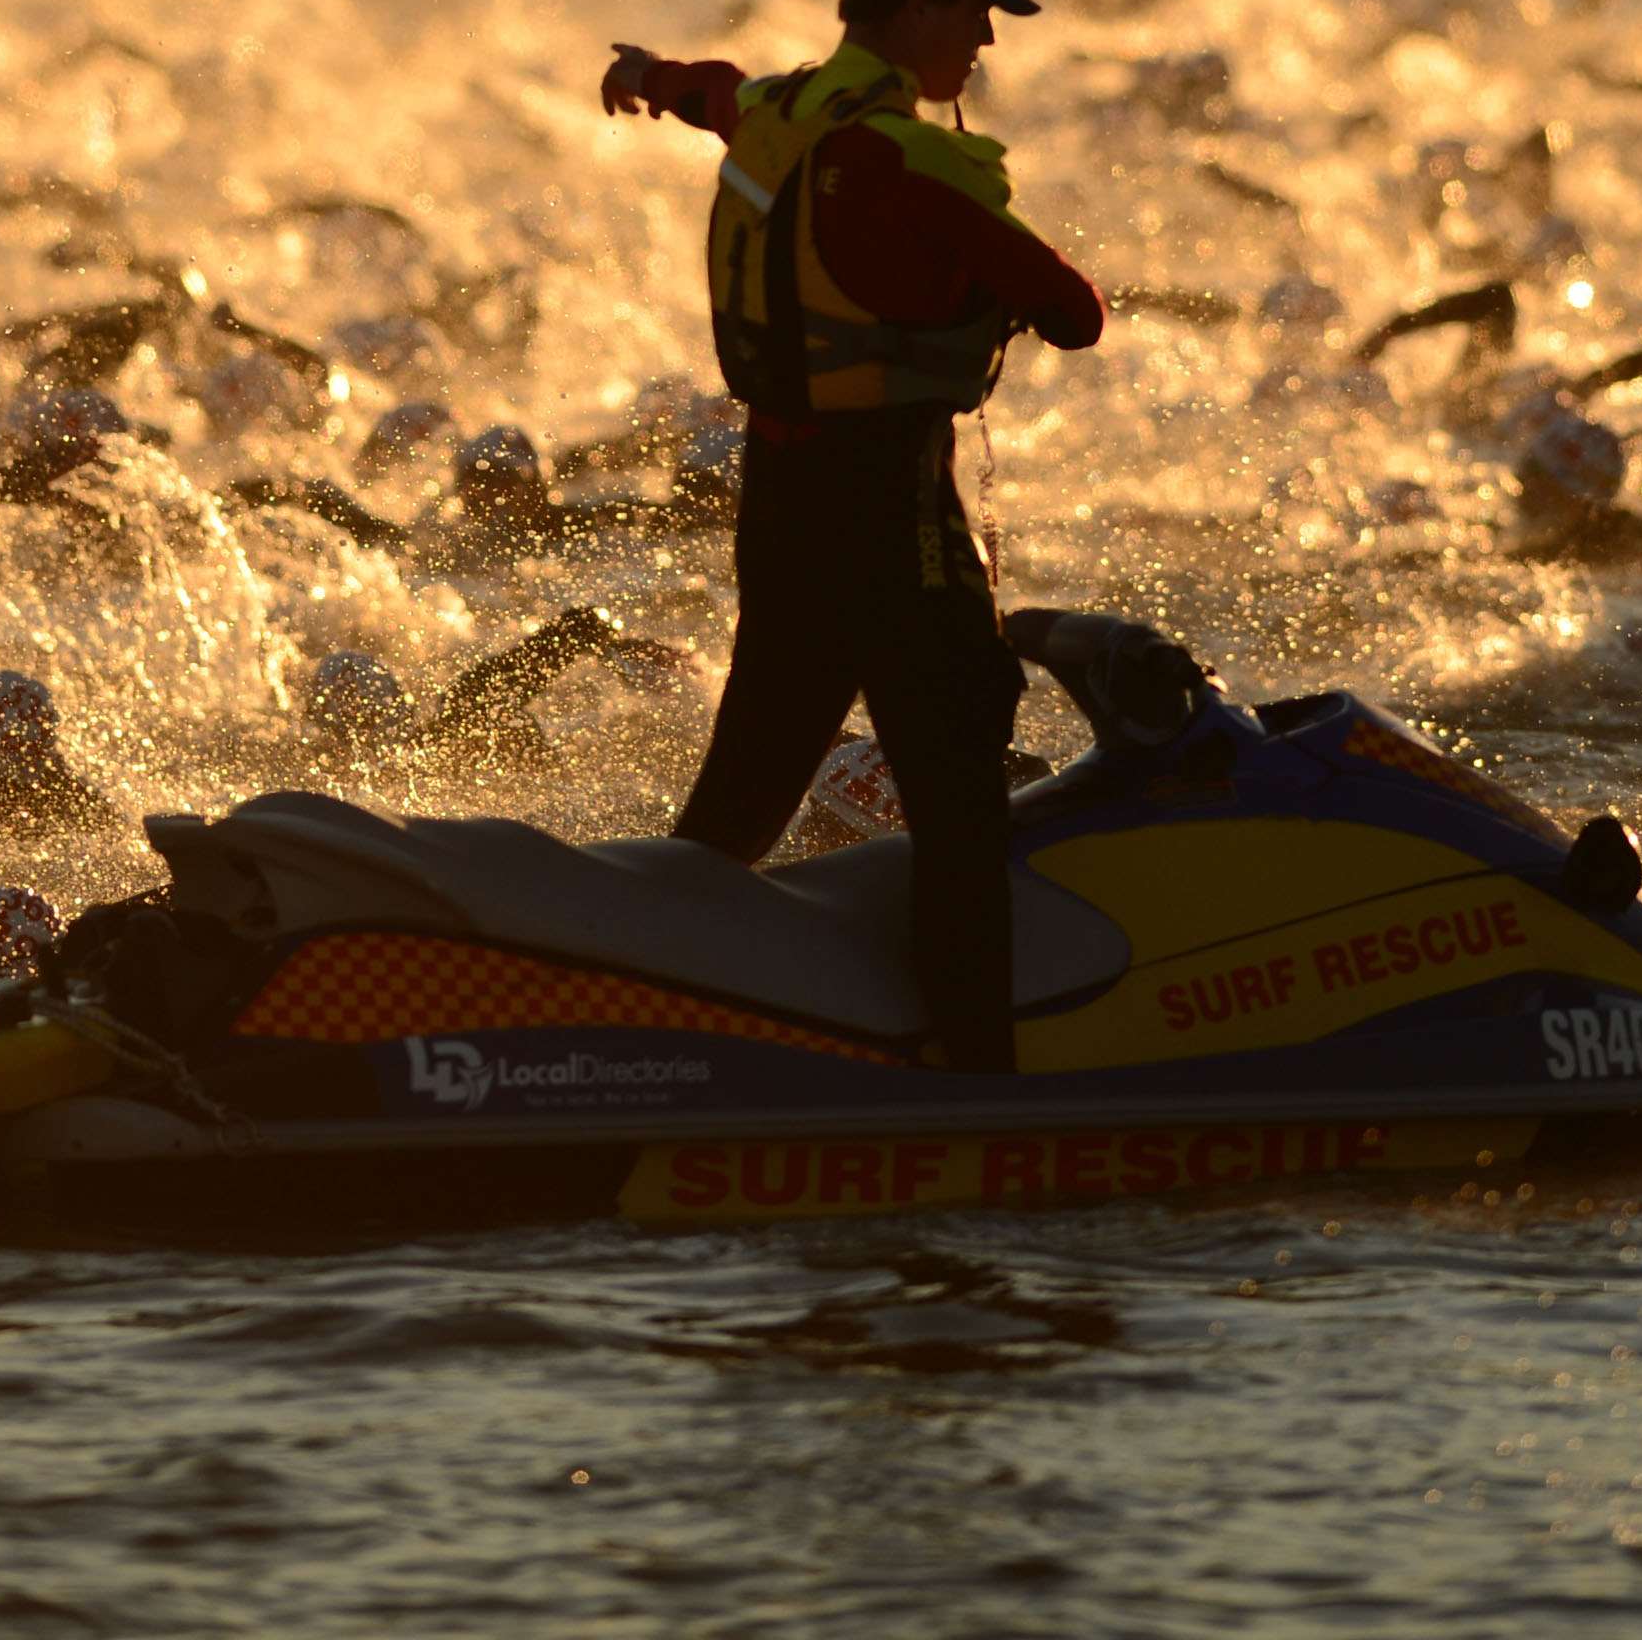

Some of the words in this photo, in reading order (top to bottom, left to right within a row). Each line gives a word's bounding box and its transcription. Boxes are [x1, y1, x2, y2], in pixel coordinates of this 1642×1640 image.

[919, 520, 944, 589] ESCUE
[1158, 956, 1297, 1031] SURF
[1312, 901, 1528, 993] RESCUE
[497, 1050, 712, 1088] LocalDirectories
[670, 1140, 950, 1208] SURF
[981, 1127, 1391, 1211] RESCUE
